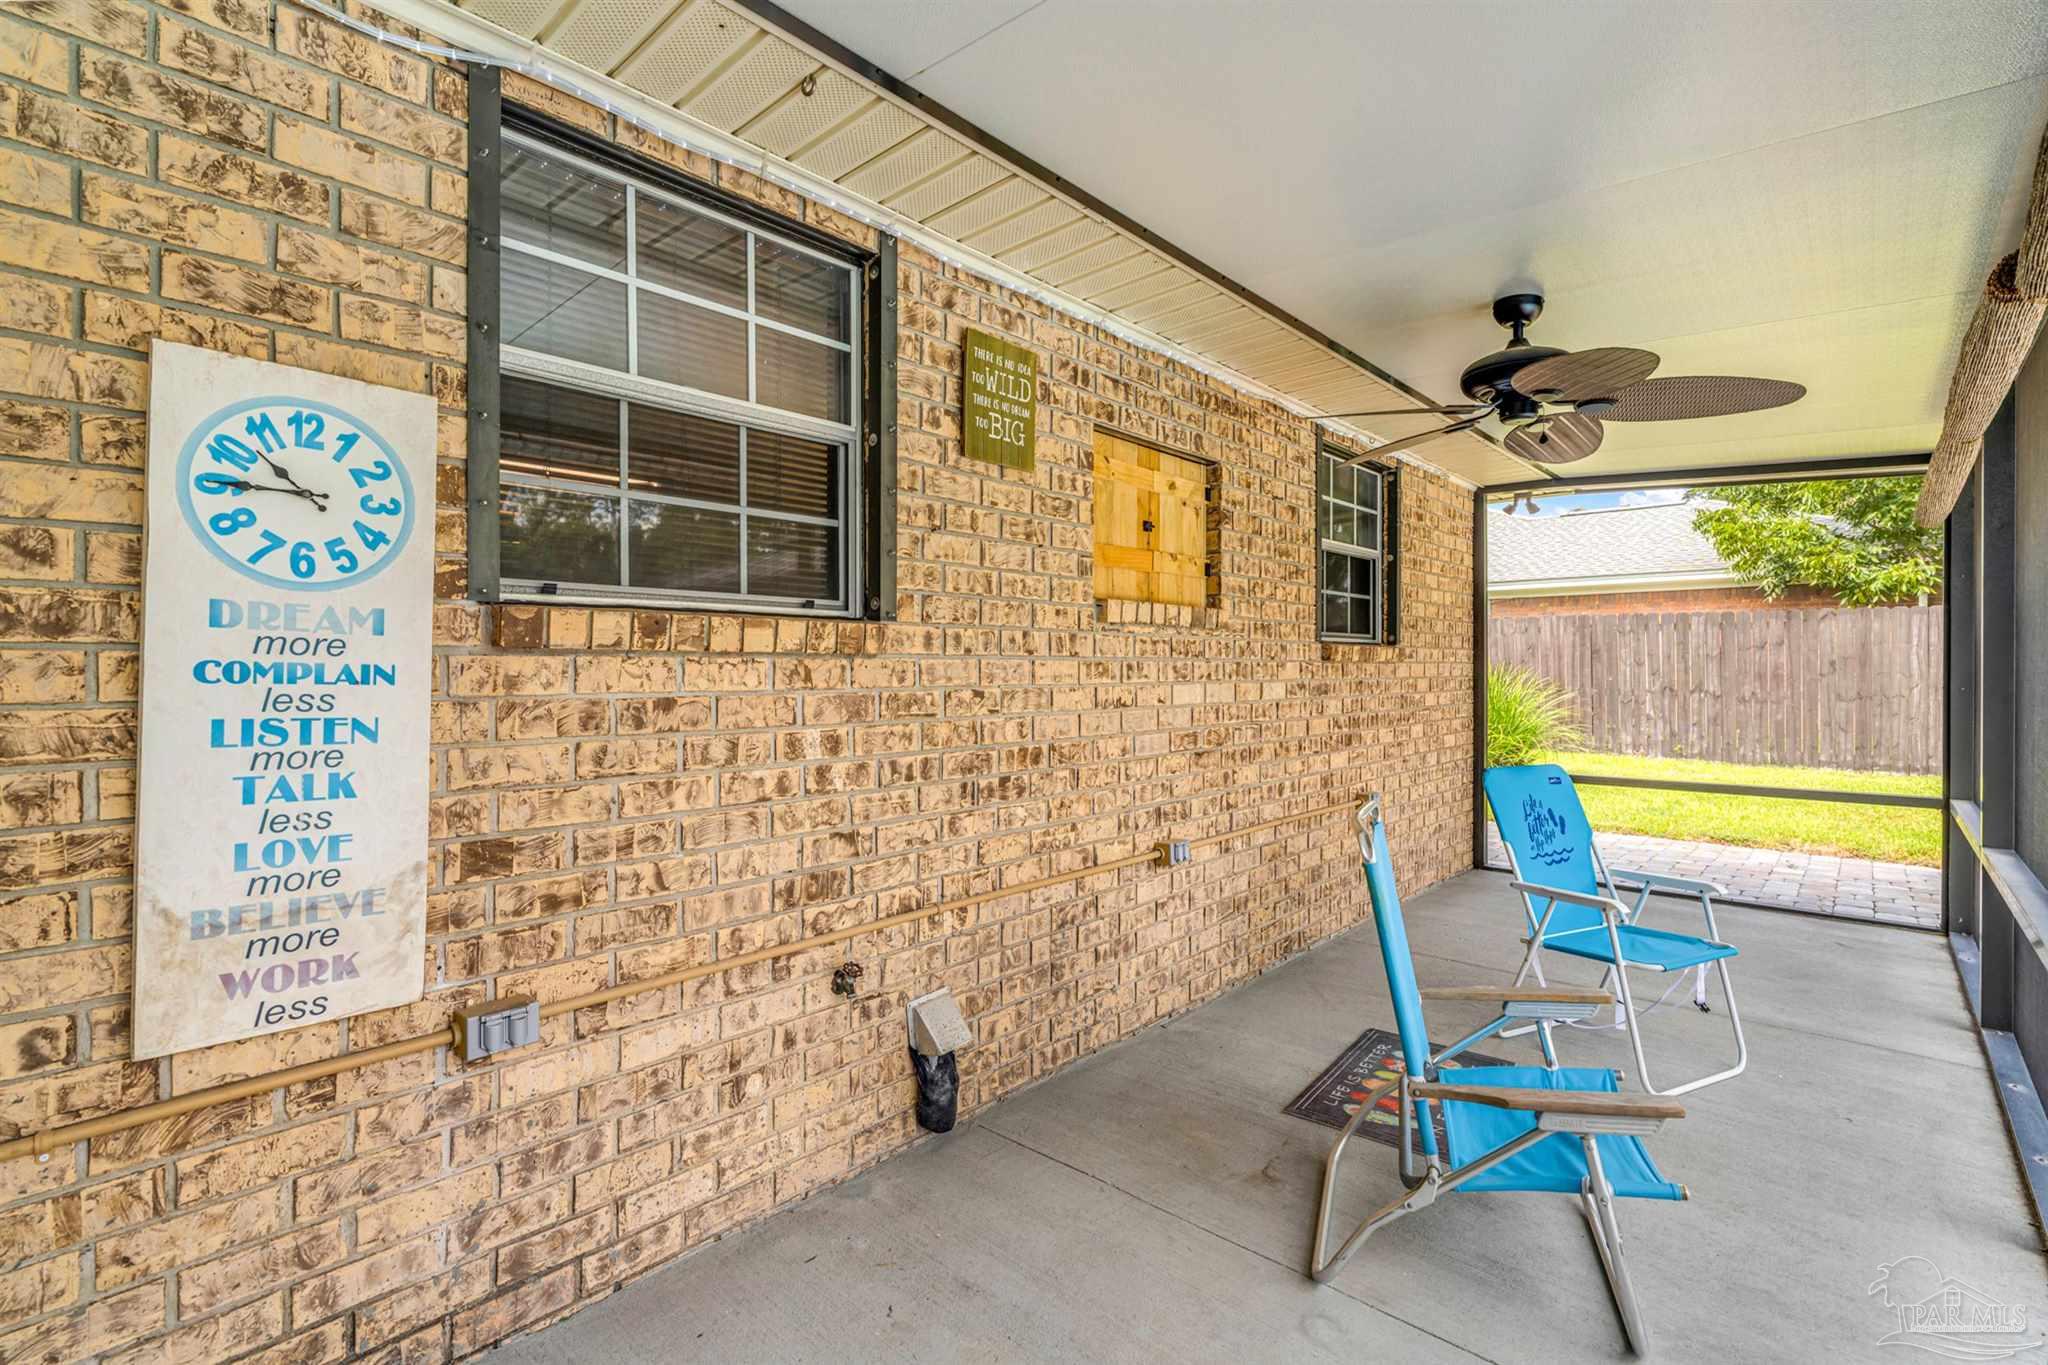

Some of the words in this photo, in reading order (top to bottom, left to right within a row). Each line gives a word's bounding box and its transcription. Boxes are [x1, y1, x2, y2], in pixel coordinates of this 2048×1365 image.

[974, 346, 994, 363] THERE
[996, 355, 1003, 367] IS
[1004, 358, 1015, 371] NO
[972, 371, 985, 385] TOO
[985, 367, 1032, 403] WILD
[973, 392, 992, 409] THERE
[993, 399, 1000, 410] IS
[1001, 402, 1010, 413] NO
[245, 412, 287, 453] 11
[287, 409, 325, 451] 12
[975, 416, 989, 429] TOO
[988, 411, 1026, 447] BIG
[205, 433, 259, 473] 10
[332, 432, 361, 463] 1
[194, 472, 245, 497] 9
[349, 460, 392, 489] 2
[209, 507, 257, 536] 8
[359, 494, 401, 517] 3
[246, 529, 288, 565] 7
[352, 519, 392, 552] 4
[289, 542, 317, 579] 6
[323, 536, 358, 574] 5
[208, 598, 385, 636] DREAM
[252, 635, 346, 657] more
[193, 660, 396, 686] COMPLAIN
[261, 688, 336, 713] less
[210, 717, 379, 748] LISTEN
[249, 749, 344, 772] more
[232, 771, 357, 806] TALK
[258, 808, 333, 834] less
[233, 833, 353, 873] LOVE
[247, 868, 342, 897] more
[190, 887, 386, 941] BELIEVE
[245, 927, 340, 960] more
[218, 951, 361, 1001] WORK
[254, 995, 329, 1028] less
[1323, 1084, 1351, 1106] LIFE
[1344, 1074, 1361, 1086] IS
[1353, 1044, 1393, 1073] BETTER
